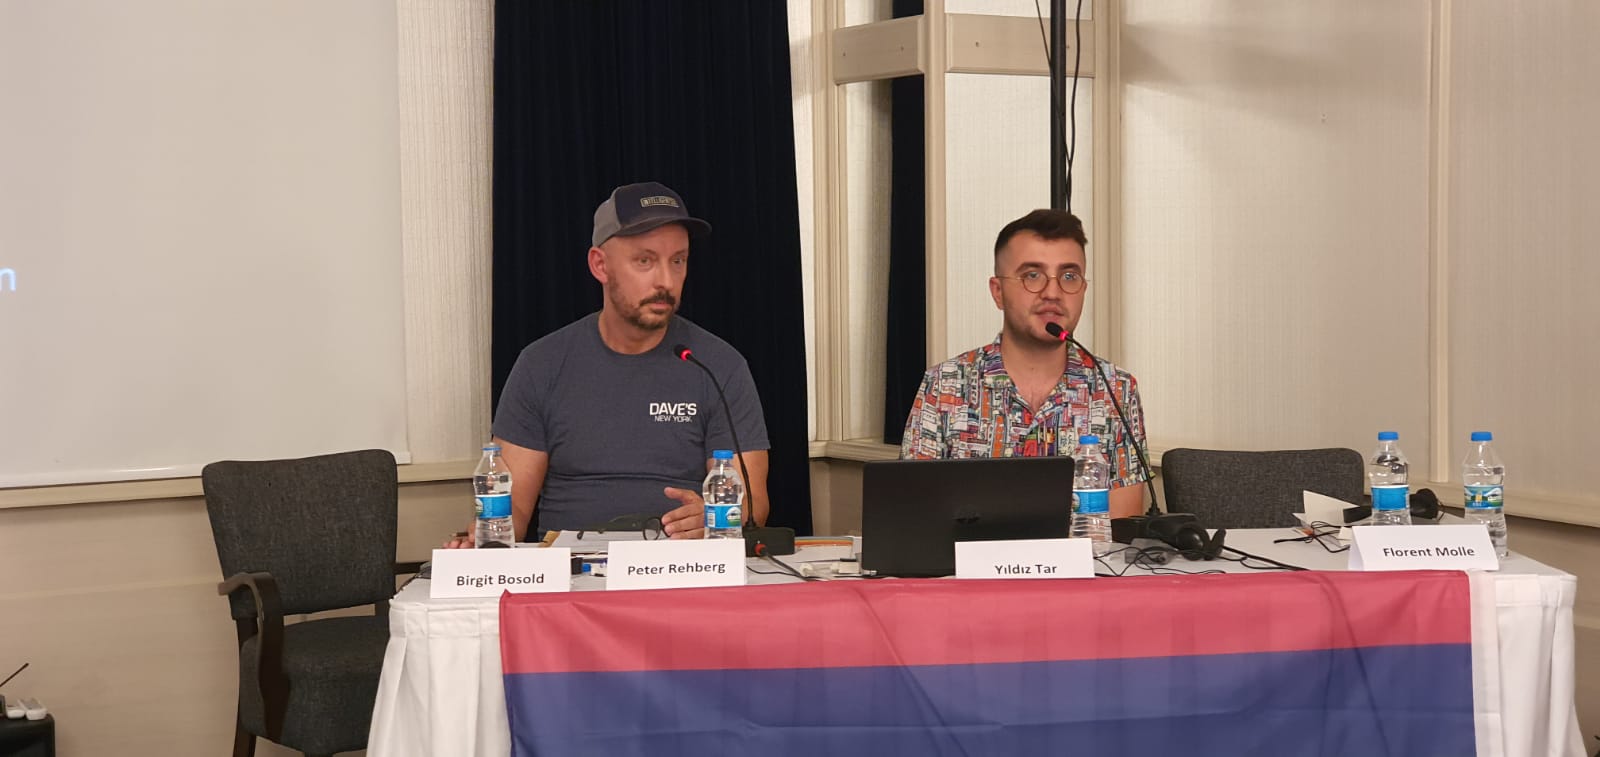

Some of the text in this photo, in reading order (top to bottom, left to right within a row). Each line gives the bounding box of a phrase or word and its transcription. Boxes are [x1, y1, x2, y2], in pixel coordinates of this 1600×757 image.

[650, 402, 697, 416] DAVE'S
[672, 415, 693, 423] YORK
[1382, 546, 1475, 557] Florent Molle
[627, 562, 726, 576] Peter Rehberg
[1034, 564, 1058, 574] Tar
[456, 573, 544, 588] Birgit Bosold
